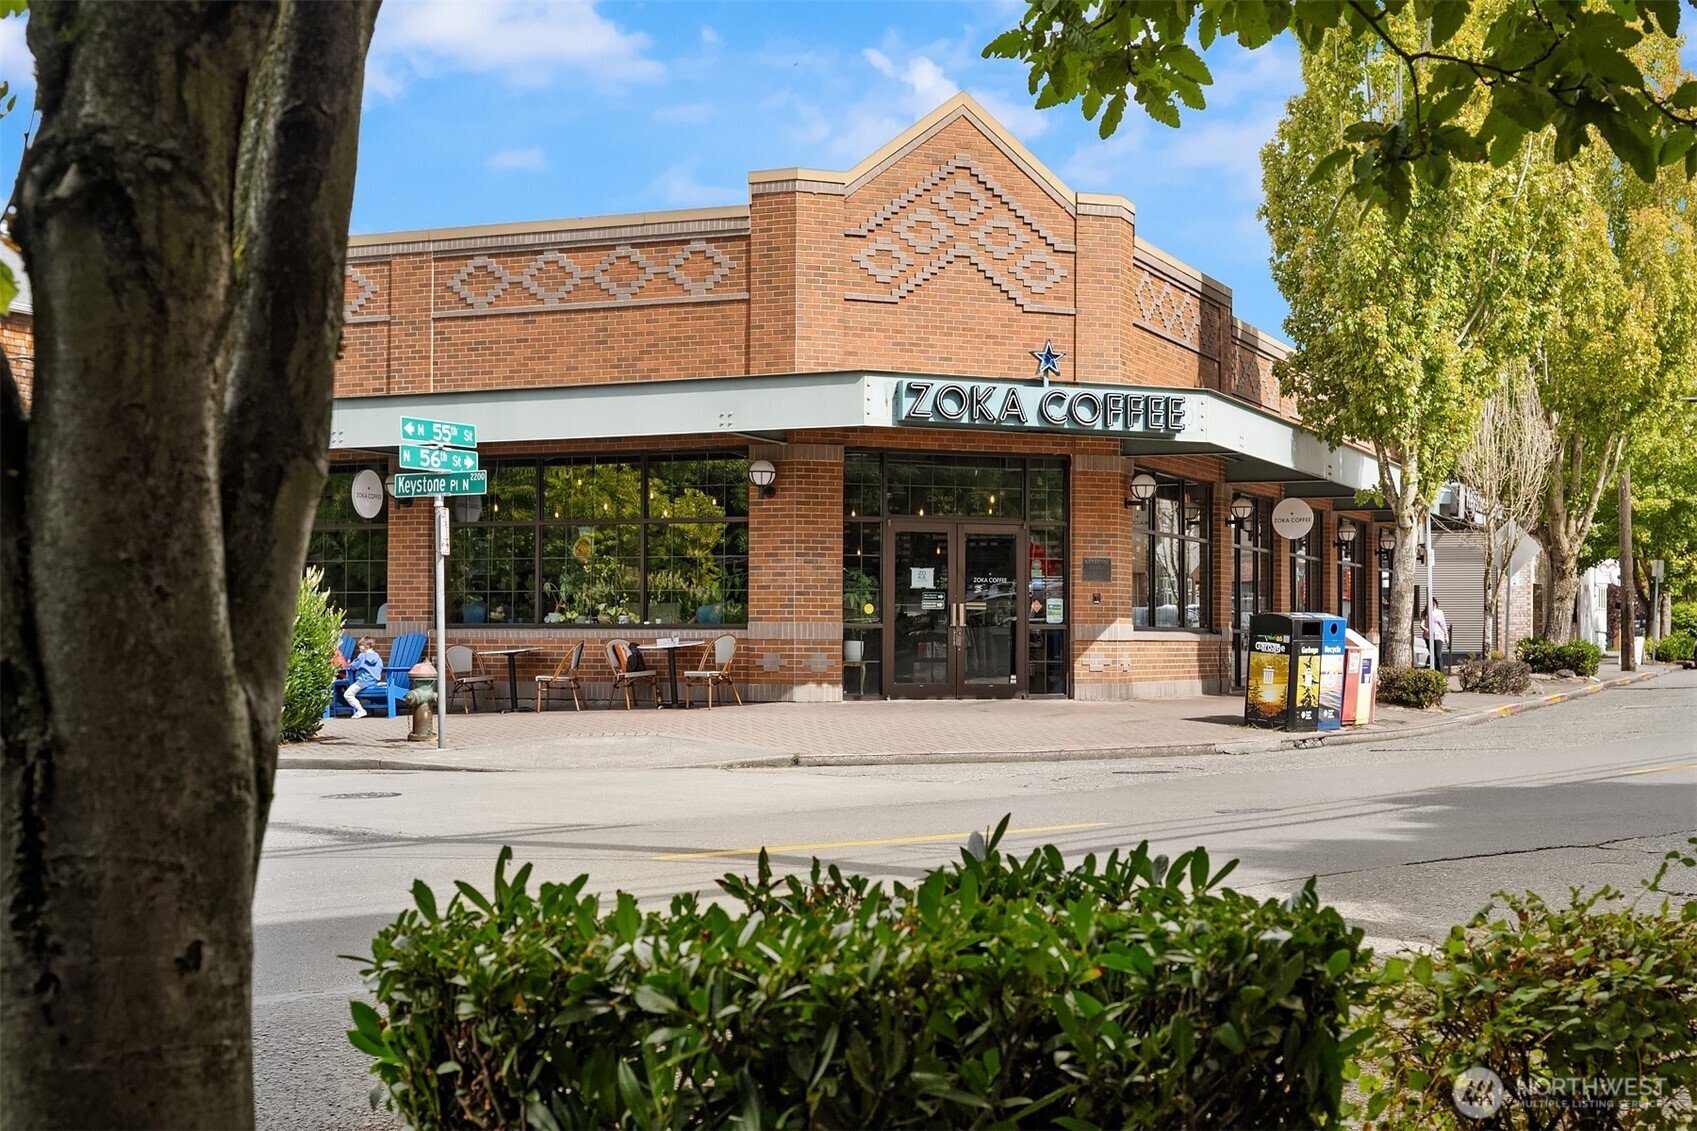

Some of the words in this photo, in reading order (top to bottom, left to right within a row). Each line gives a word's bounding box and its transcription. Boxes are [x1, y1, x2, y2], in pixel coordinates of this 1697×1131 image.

[907, 382, 1028, 424] ZOKA
[1040, 390, 1186, 431] COFFEE
[417, 424, 425, 436] N
[432, 423, 458, 441] 55th
[463, 429, 474, 442] St
[403, 449, 411, 462] N
[419, 449, 448, 468] 56th
[452, 455, 462, 467] St
[470, 473, 485, 481] 2200
[398, 476, 446, 495] Keystone
[450, 480, 459, 491] Pl
[462, 479, 469, 491] N
[1255, 641, 1286, 654] Garbage
[1301, 646, 1319, 655] Garbage
[1324, 645, 1342, 655] Recycle
